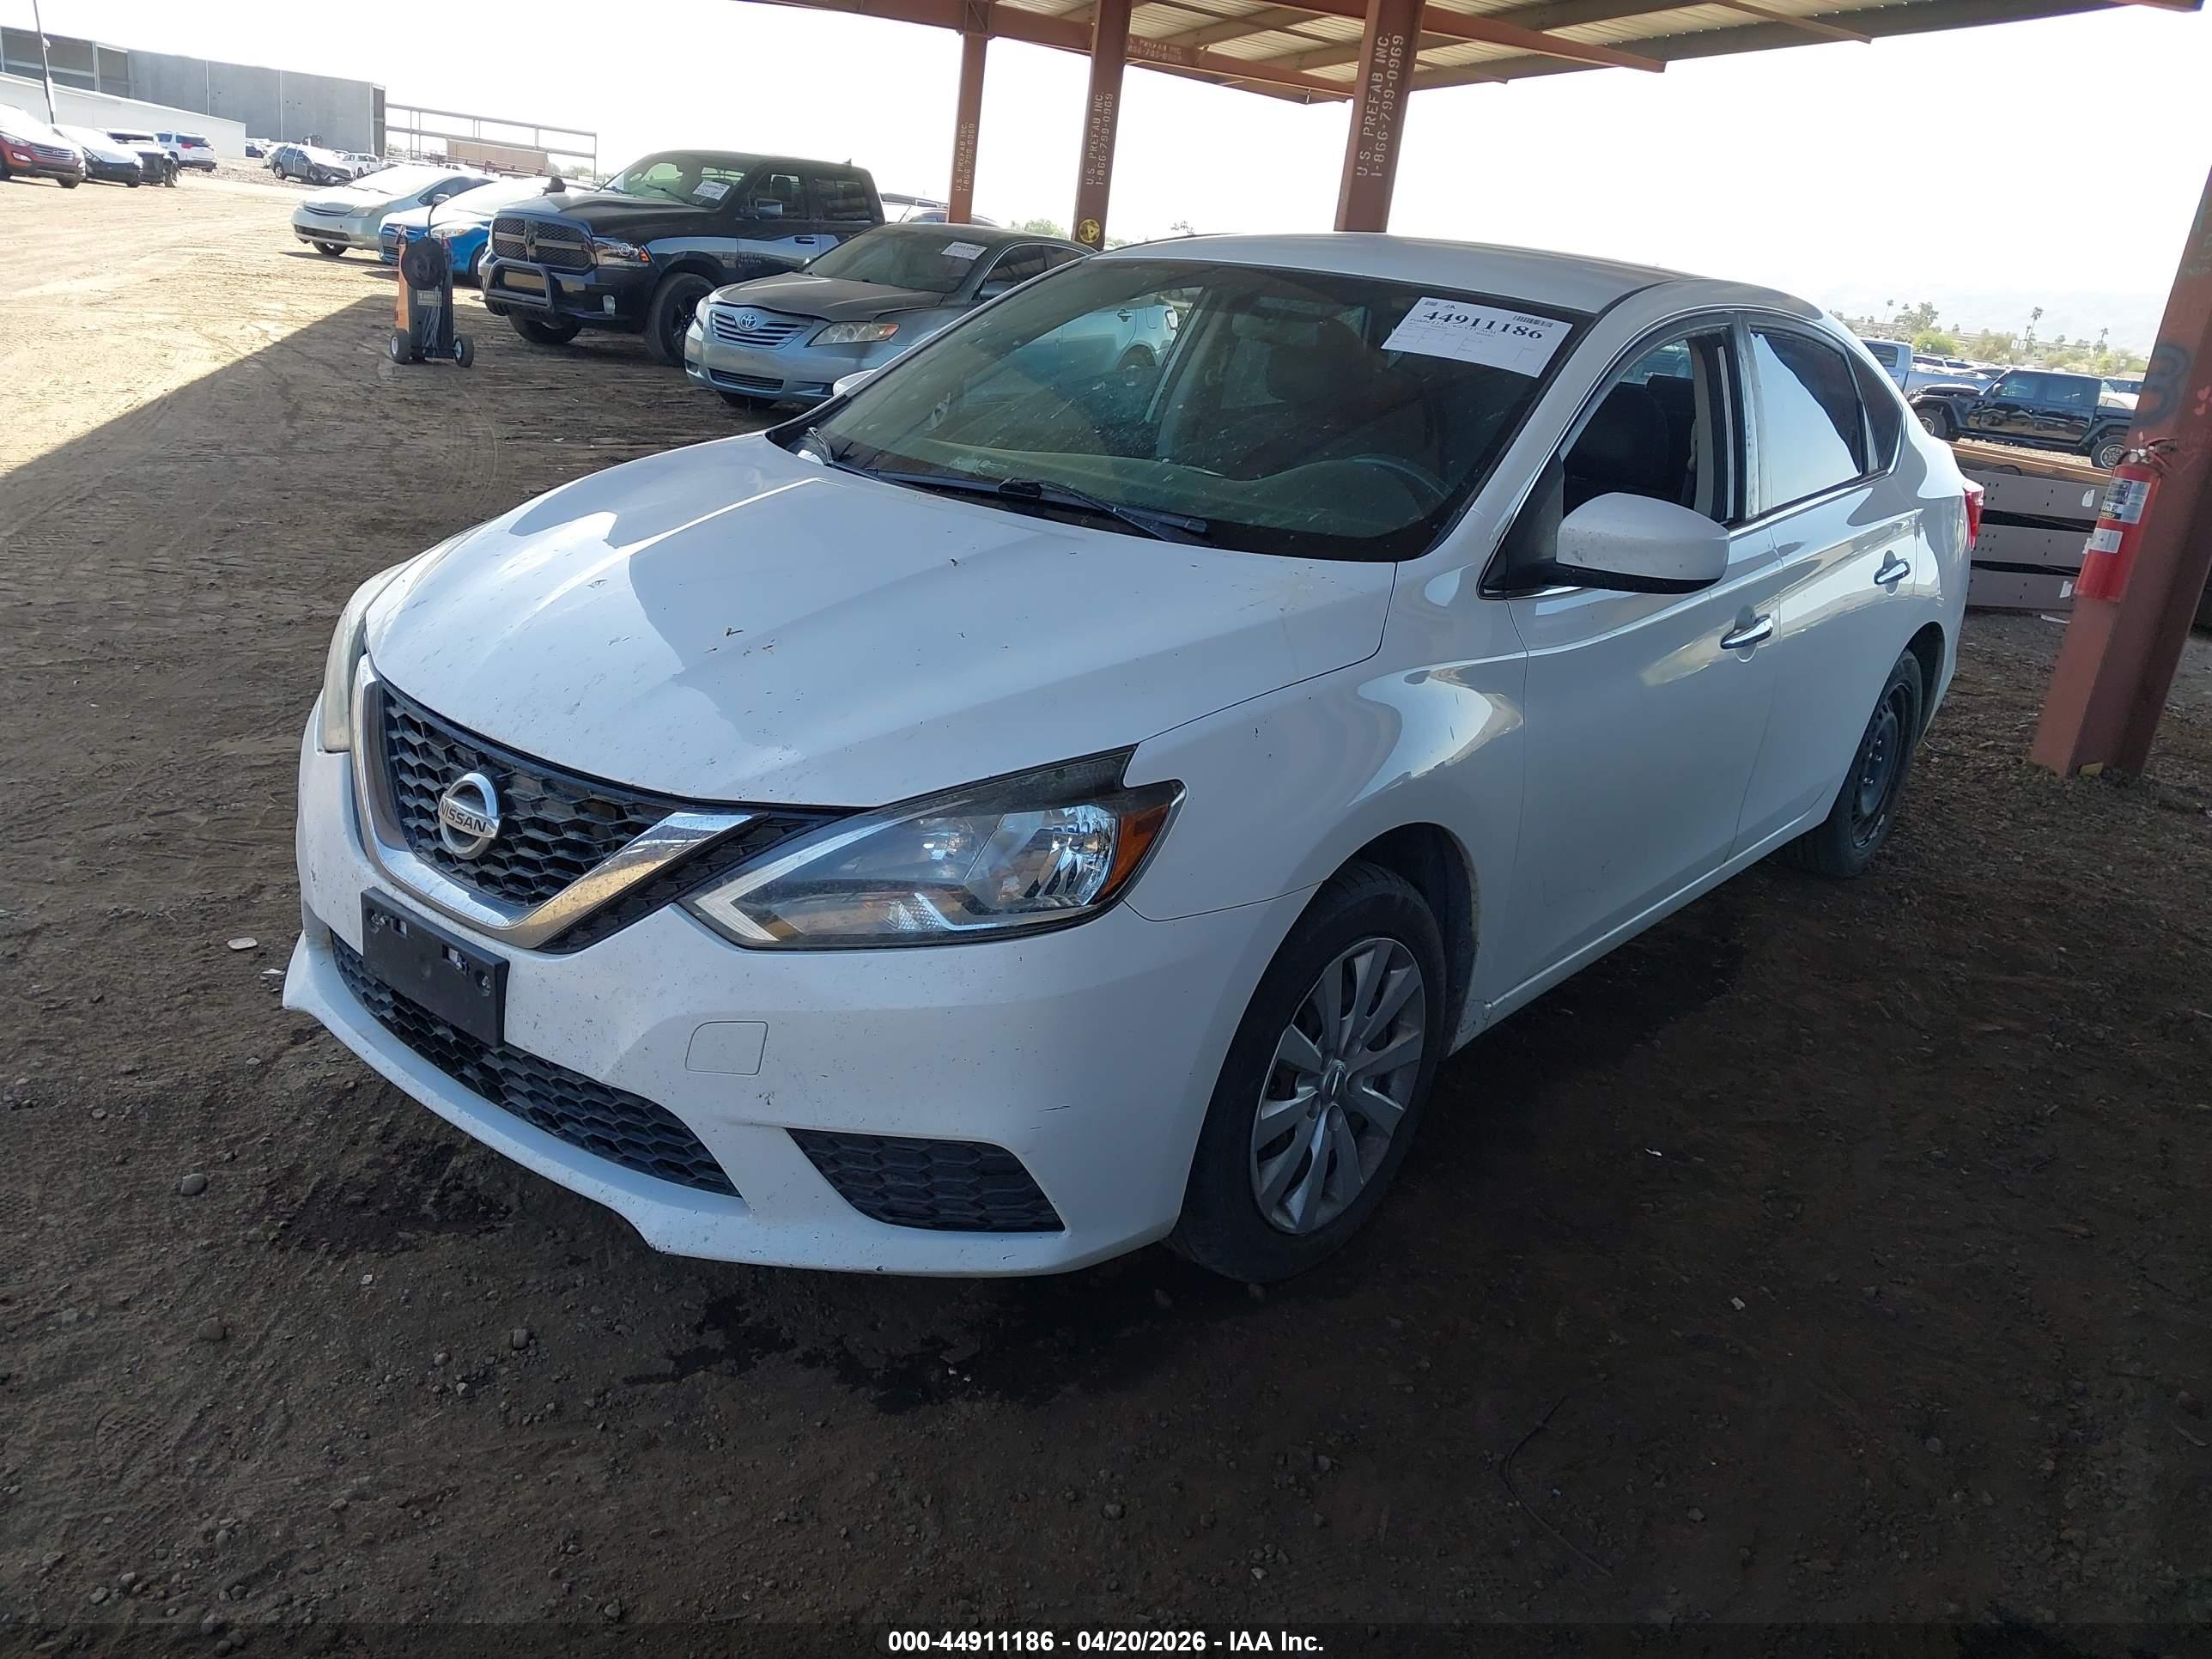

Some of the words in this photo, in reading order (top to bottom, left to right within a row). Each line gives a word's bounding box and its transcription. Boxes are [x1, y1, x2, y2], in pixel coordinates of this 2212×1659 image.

[1375, 33, 1391, 64] INC.
[1094, 91, 1104, 112] INC.
[1363, 73, 1383, 136] PREFAB
[1370, 34, 1404, 177] 1-866-799-0969
[1089, 118, 1101, 159] PREFAB
[1357, 146, 1373, 176] U.S.
[1423, 310, 1547, 339] 44911186
[439, 799, 487, 833] NISSAN
